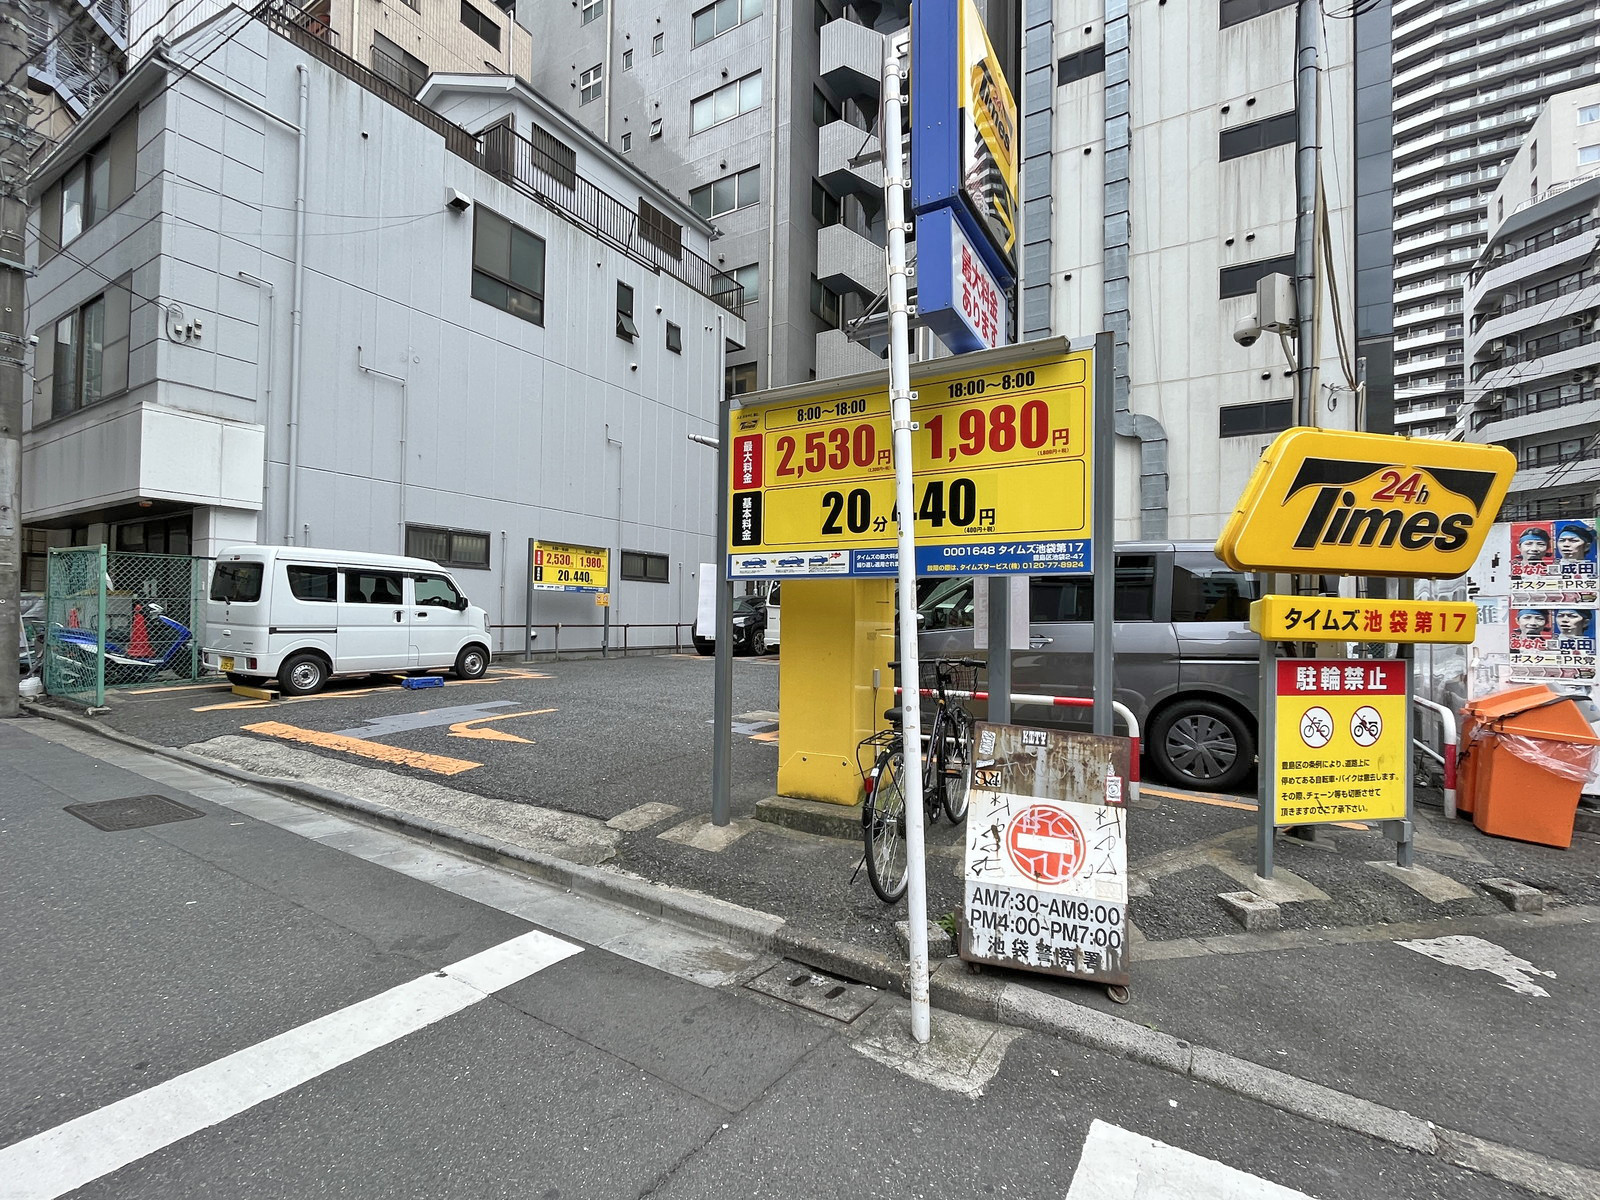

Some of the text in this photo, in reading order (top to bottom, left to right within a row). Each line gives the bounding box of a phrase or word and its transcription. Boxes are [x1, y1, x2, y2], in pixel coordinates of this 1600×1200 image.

[962, 245, 998, 324] 最大料金
[963, 283, 998, 348] あります
[776, 424, 891, 478] 2,530円
[924, 400, 1070, 463] 1,980円
[742, 440, 753, 484] 最大料金
[741, 497, 752, 541] 基本料金
[821, 488, 888, 534] 20分
[1293, 487, 1474, 552] Times
[943, 543, 1084, 557] 0001648 タイムズ池袋第17
[1296, 666, 1388, 691] 駐輪禁止
[1281, 759, 1370, 770] 豊島区の条例により、道路上に
[988, 936, 1101, 969] 池袋警察署
